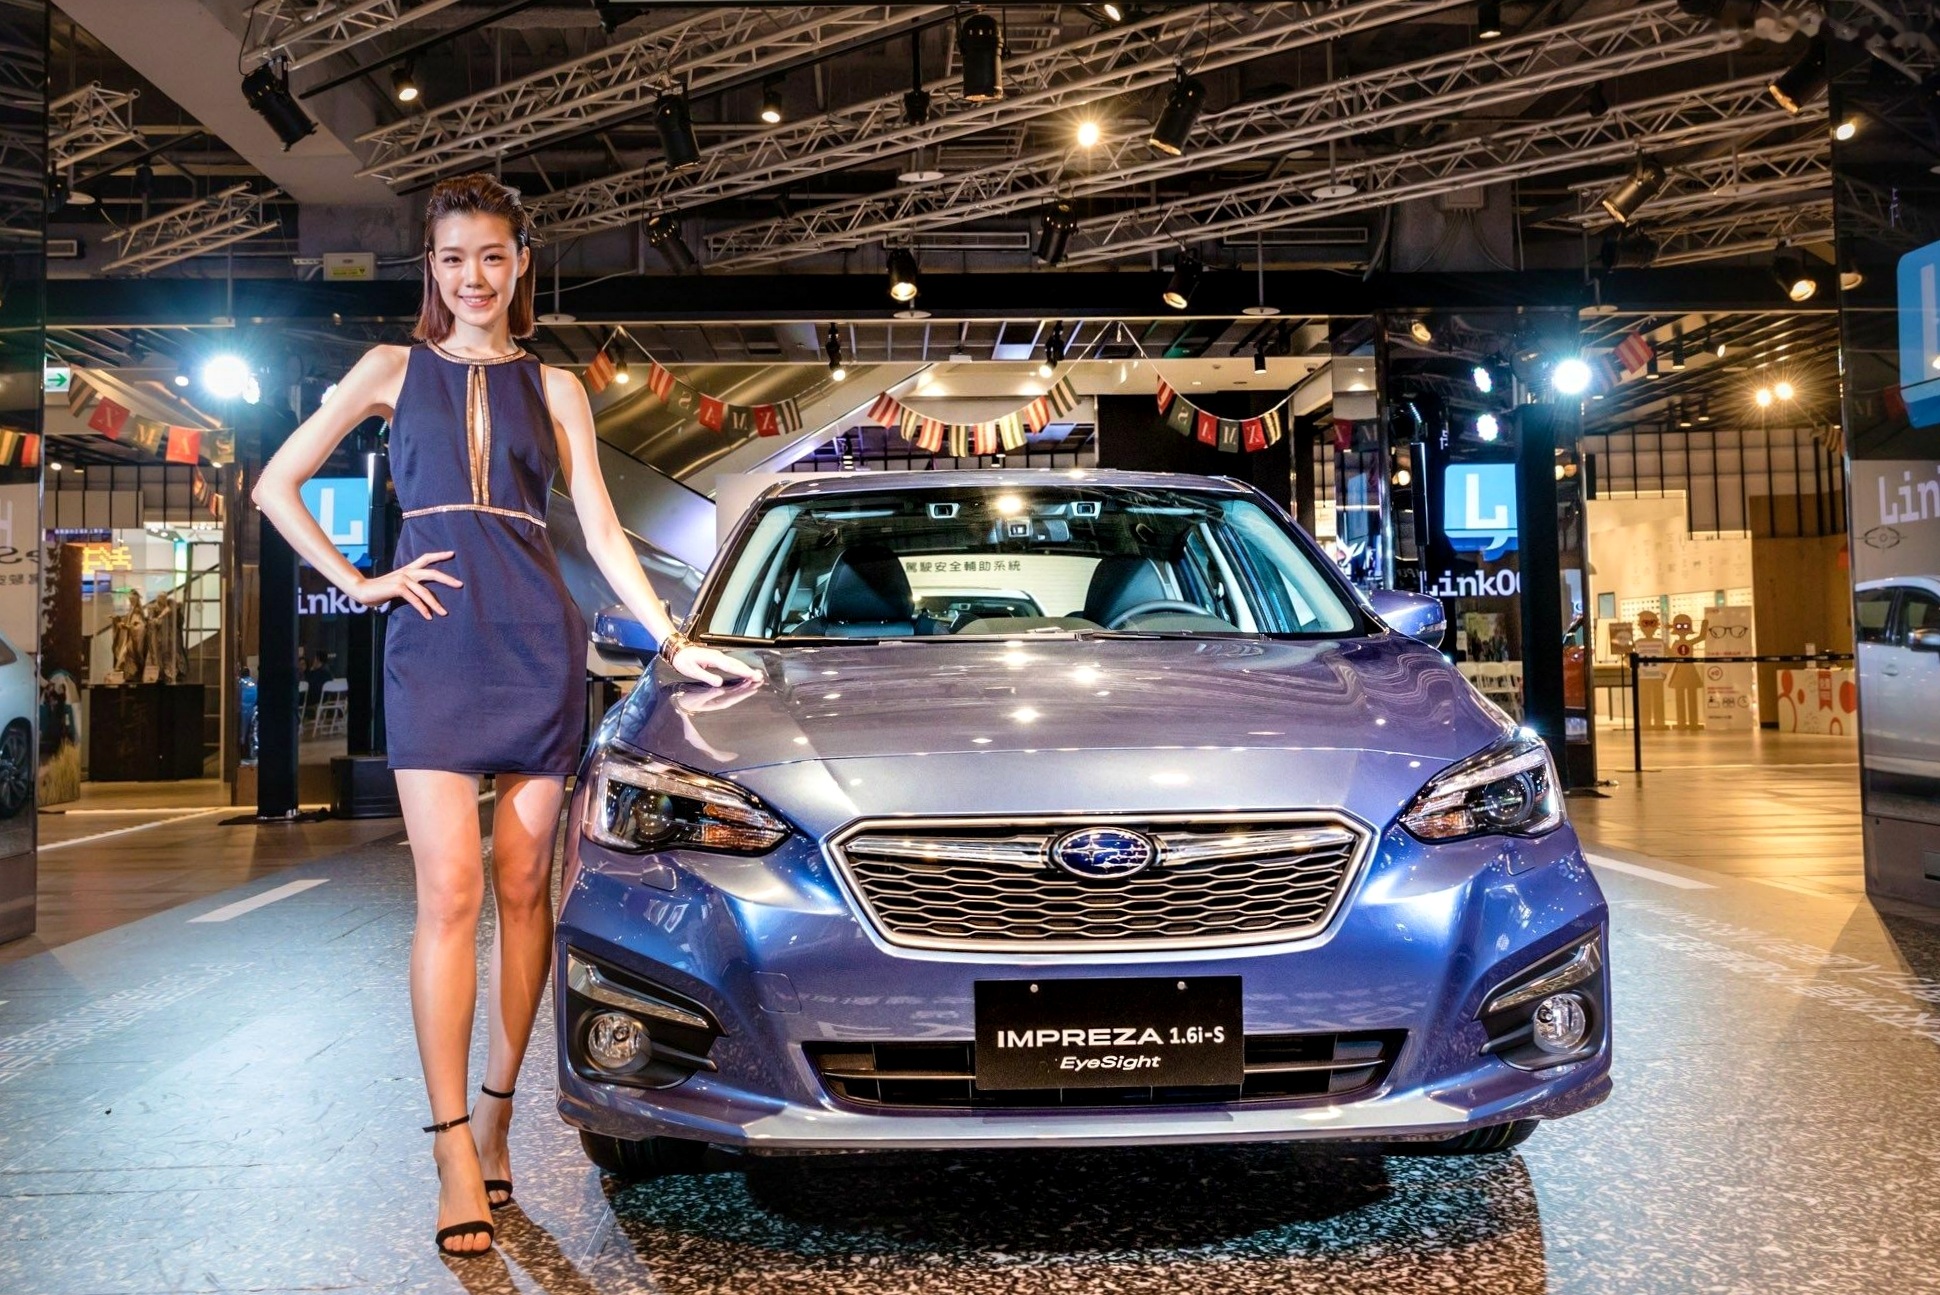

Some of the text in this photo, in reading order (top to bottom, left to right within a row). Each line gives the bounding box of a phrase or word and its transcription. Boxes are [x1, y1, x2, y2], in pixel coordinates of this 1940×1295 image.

[1465, 473, 1508, 529] L
[1878, 466, 1940, 525] Lin
[906, 561, 1021, 573] 駕駛安全輔助系統
[1420, 569, 1520, 597] LinkO
[997, 1026, 1225, 1048] IMPREZA 1.6i-S
[1060, 1055, 1161, 1071] EyeSight
